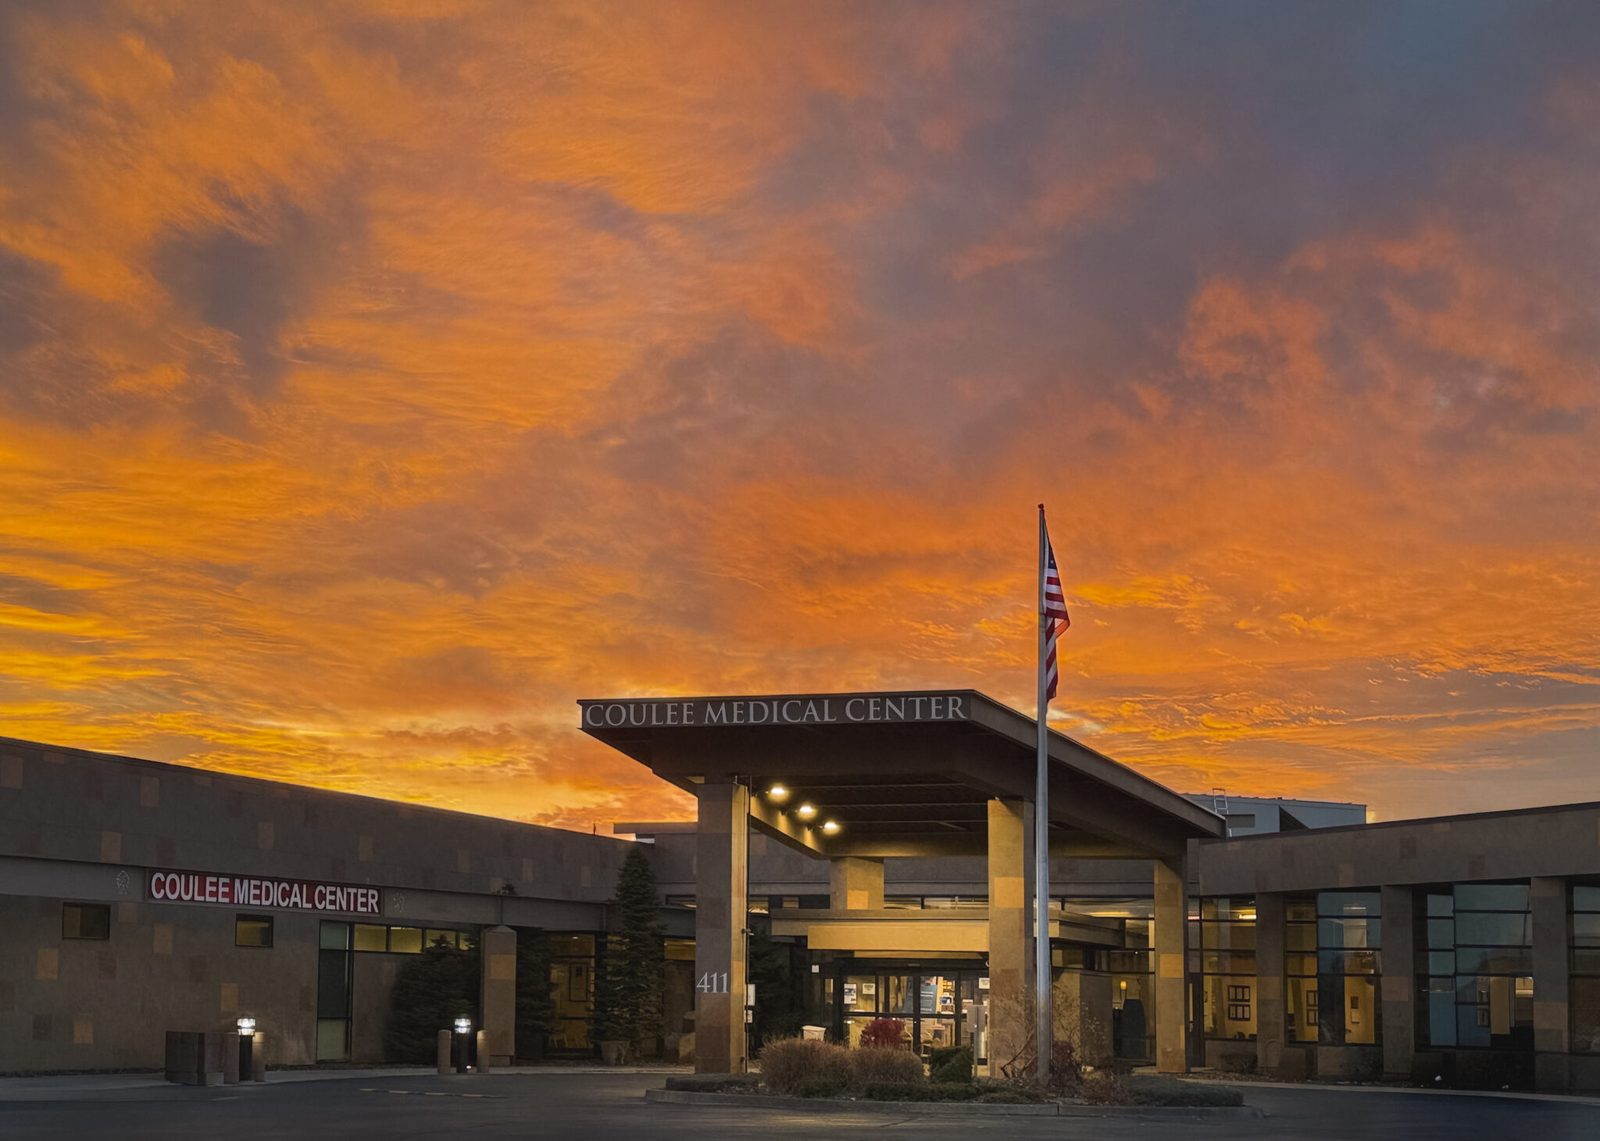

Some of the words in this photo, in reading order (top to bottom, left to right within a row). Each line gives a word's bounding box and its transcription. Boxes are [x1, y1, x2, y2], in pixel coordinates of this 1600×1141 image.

[585, 702, 695, 727] COULEE
[703, 699, 836, 725] MEDICAL
[845, 696, 968, 721] CENTER
[151, 872, 230, 903] COULEE
[233, 878, 312, 909] MEDICAL
[314, 885, 379, 913] CENTER
[696, 972, 729, 993] 411
